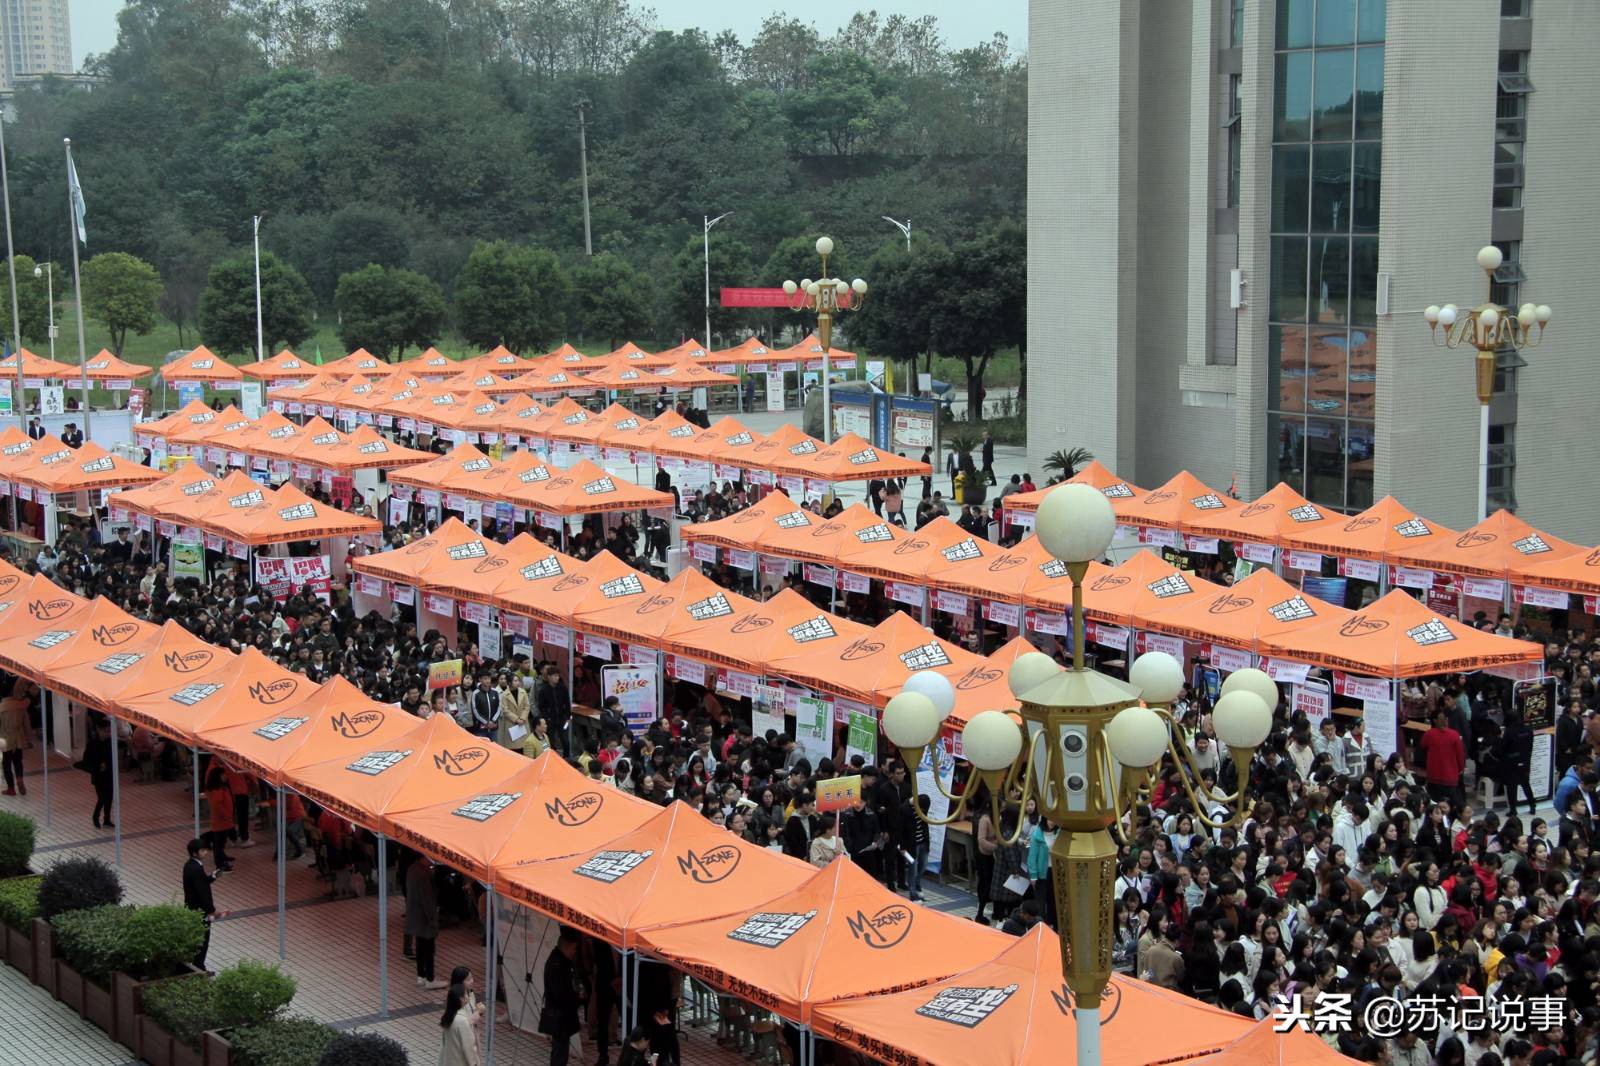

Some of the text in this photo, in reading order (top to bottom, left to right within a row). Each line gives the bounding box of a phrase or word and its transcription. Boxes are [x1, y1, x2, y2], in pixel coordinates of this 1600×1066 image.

[164, 649, 215, 673] M-ZONE
[248, 678, 299, 705] M-ZONE
[330, 710, 386, 738] M-ZONE
[433, 746, 490, 776] M-ZONE
[544, 792, 604, 827] M-ZONE
[676, 845, 742, 884] M-ZONE
[847, 904, 914, 949] M-ZONE
[728, 975, 780, 1008] 无处不玩乐
